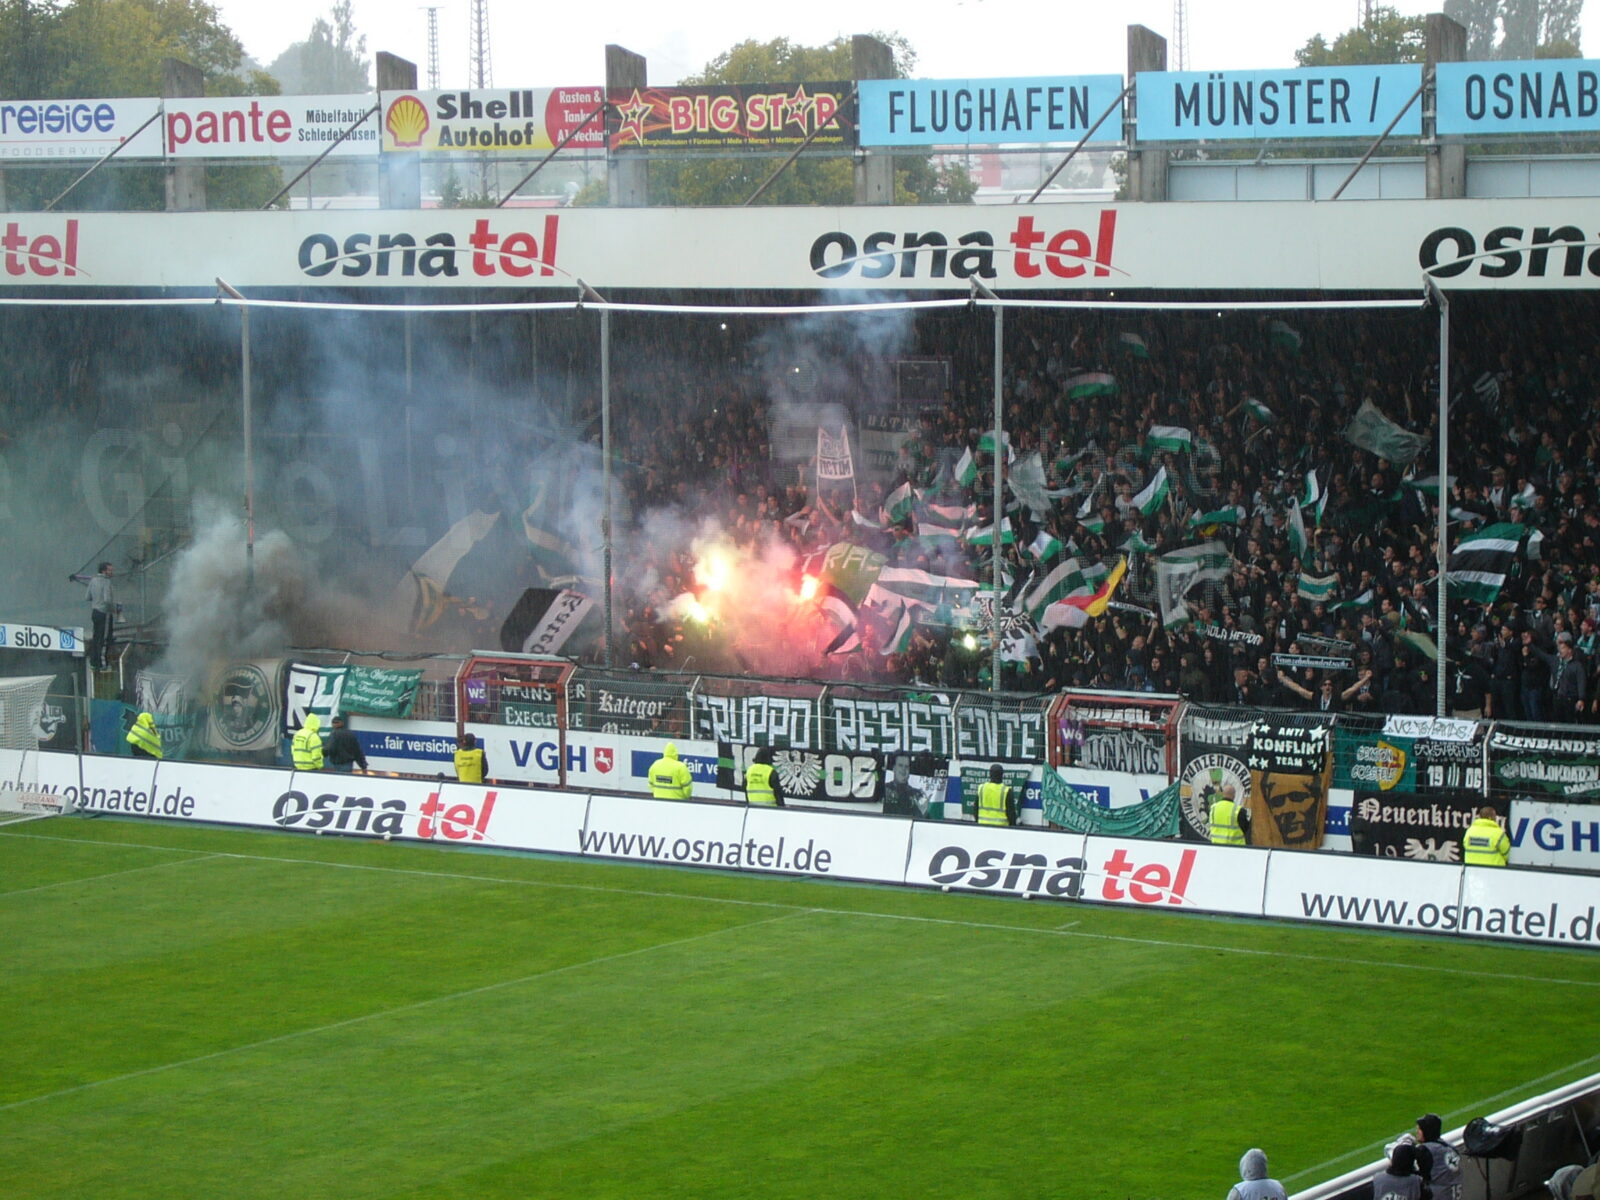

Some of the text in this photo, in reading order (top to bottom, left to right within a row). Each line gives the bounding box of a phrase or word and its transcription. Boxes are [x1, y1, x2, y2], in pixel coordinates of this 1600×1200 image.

[436, 90, 534, 120] Shell
[559, 91, 592, 103] Rasten
[888, 85, 1090, 134] FLUGHAFEN
[1173, 73, 1352, 127] MÜNSTER
[1464, 71, 1600, 121] OSNAB
[168, 101, 292, 153] pante
[563, 108, 598, 123] Tankn
[670, 94, 739, 135] BIG
[438, 123, 534, 148] Autohof
[2, 218, 80, 278] tel
[1418, 224, 1600, 279] osn
[15, 627, 51, 649] sibo
[504, 705, 583, 728] EXECUTVE
[598, 688, 670, 720] Kategor
[406, 738, 458, 755] versiche
[1252, 738, 1324, 755] KONFLIKT
[1278, 726, 1304, 737] ANTI
[510, 740, 587, 774] VGH
[1275, 755, 1304, 767] TEAM
[825, 753, 878, 798] 06
[578, 829, 833, 873] www.osnatel.de
[1510, 818, 1600, 854] VGH
